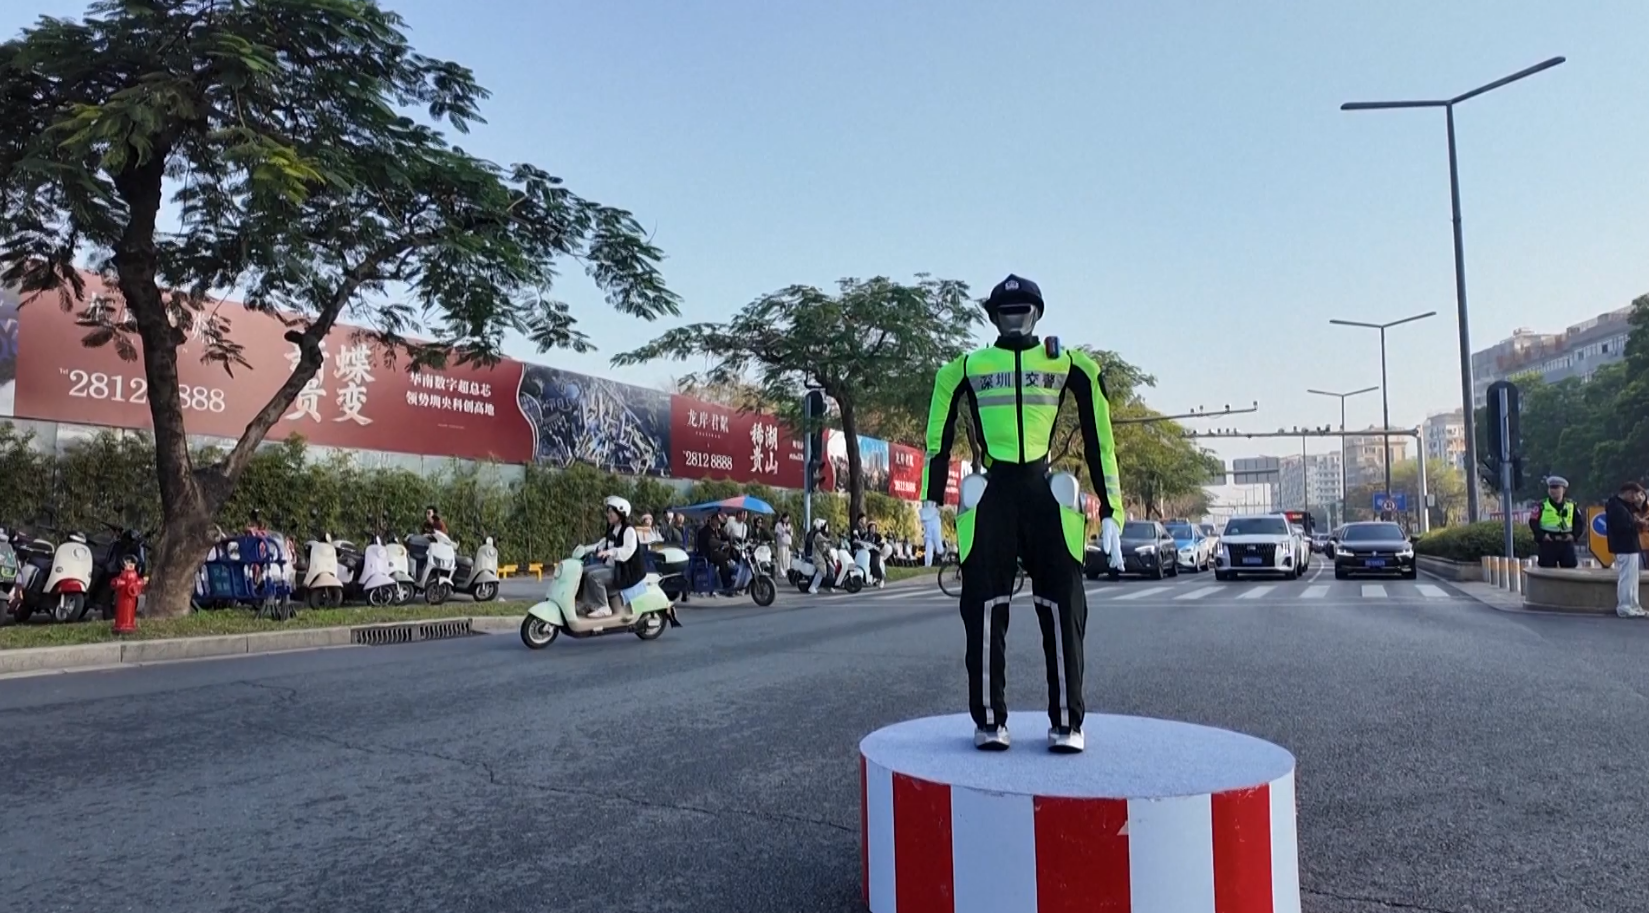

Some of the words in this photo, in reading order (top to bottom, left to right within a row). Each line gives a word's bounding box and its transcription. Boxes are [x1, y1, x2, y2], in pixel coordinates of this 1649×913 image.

[68, 369, 148, 404] 2812
[178, 384, 226, 413] 888
[333, 343, 376, 426] 蝶变
[980, 372, 1011, 390] 深圳
[1025, 371, 1056, 389] 交警
[685, 450, 709, 468] 2812
[710, 453, 733, 471] 8888
[765, 424, 779, 475] 湖山
